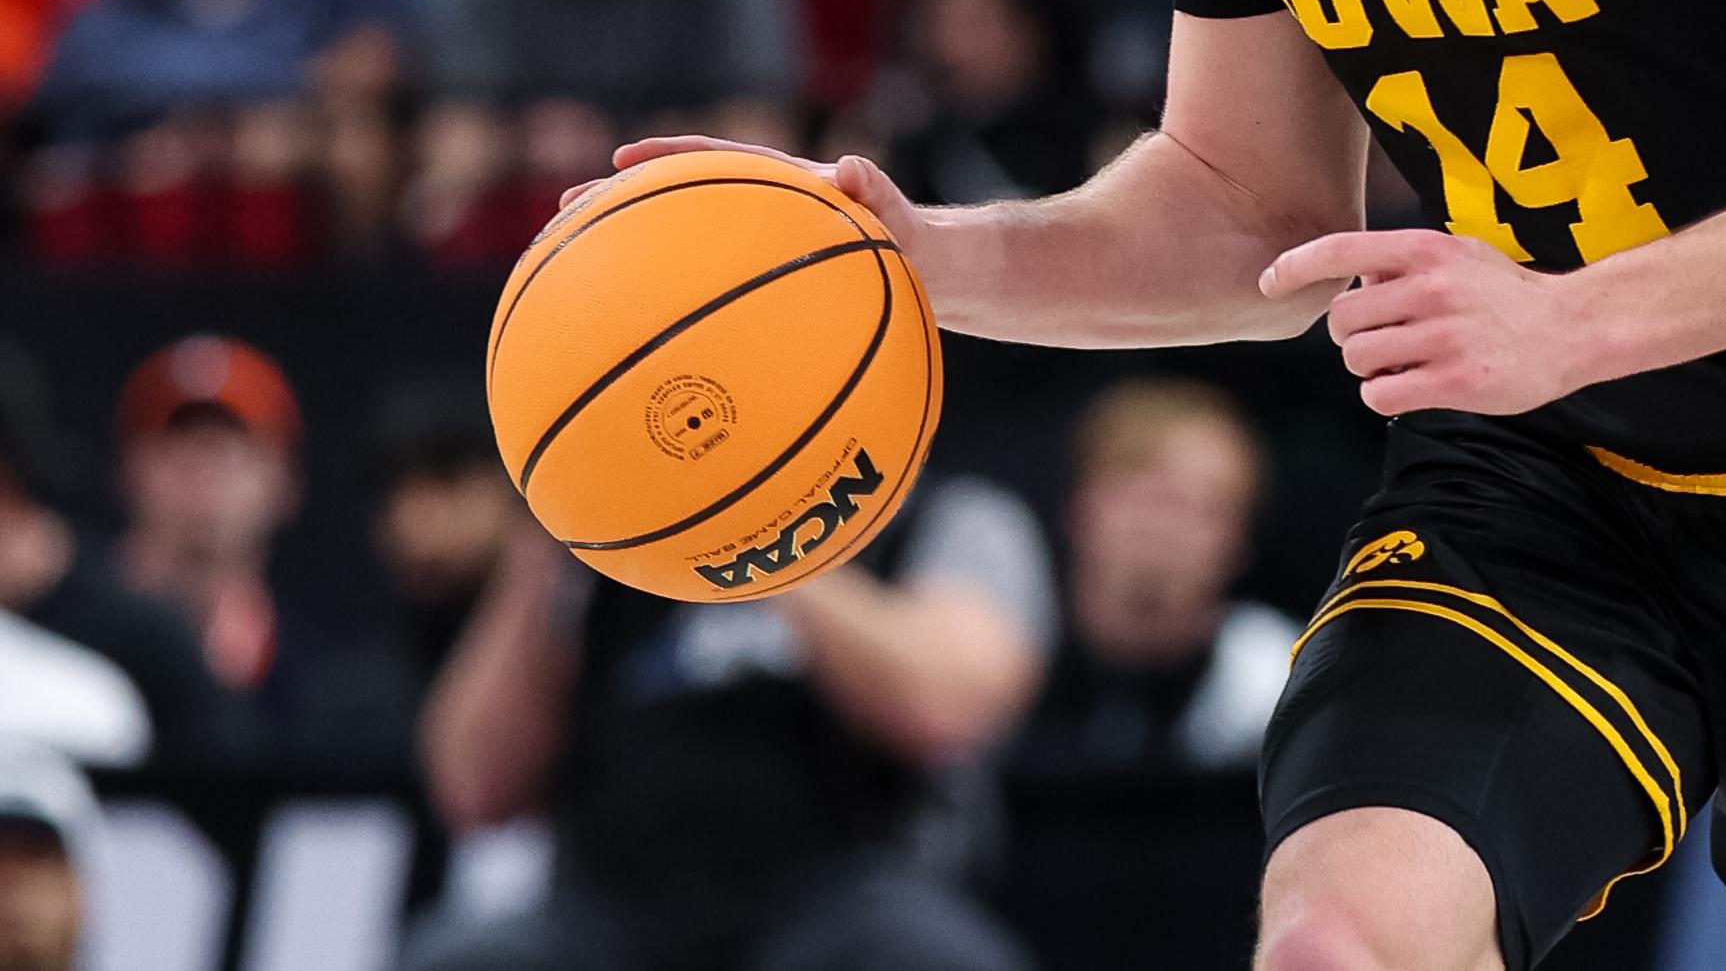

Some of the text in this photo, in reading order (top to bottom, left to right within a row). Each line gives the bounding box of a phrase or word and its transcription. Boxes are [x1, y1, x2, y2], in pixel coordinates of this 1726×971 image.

[1366, 53, 1671, 265] 14
[685, 437, 857, 562] OFFICIAL GAME BALL
[692, 447, 885, 590] NCAA
